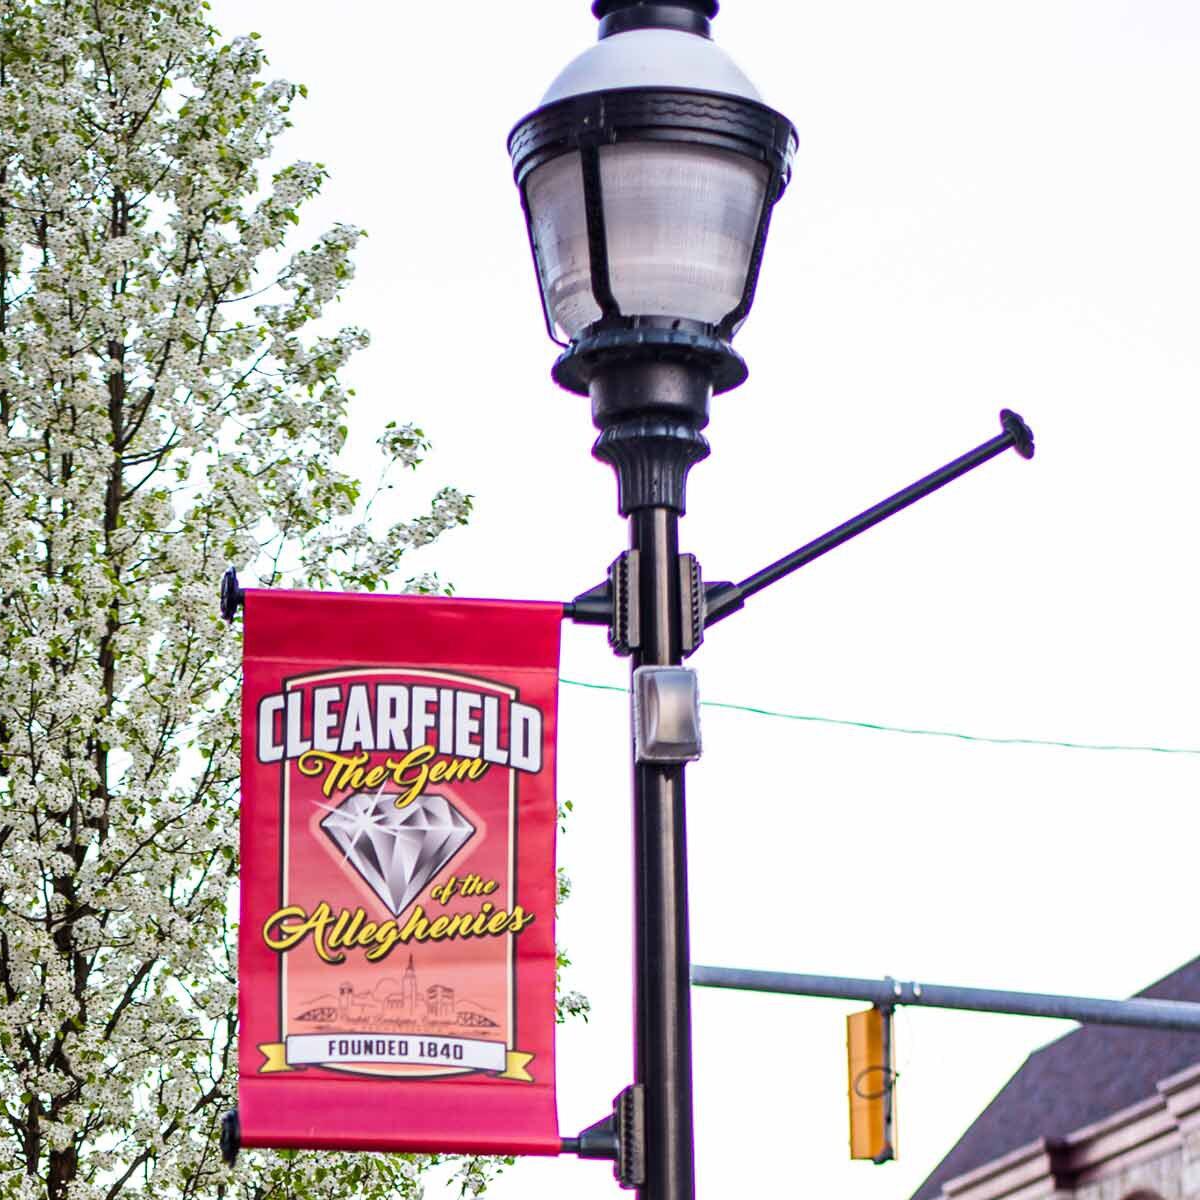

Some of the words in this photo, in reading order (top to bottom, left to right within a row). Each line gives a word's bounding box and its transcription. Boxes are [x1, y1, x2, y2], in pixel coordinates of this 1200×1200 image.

[257, 683, 543, 773] CLEARFIELD
[297, 749, 390, 797] The
[385, 745, 488, 809] Gem
[430, 875, 458, 905] of
[458, 873, 498, 896] the
[262, 901, 534, 964] Alleghenies
[328, 1039, 409, 1057] FOUNDED
[418, 1041, 464, 1060] 1840
